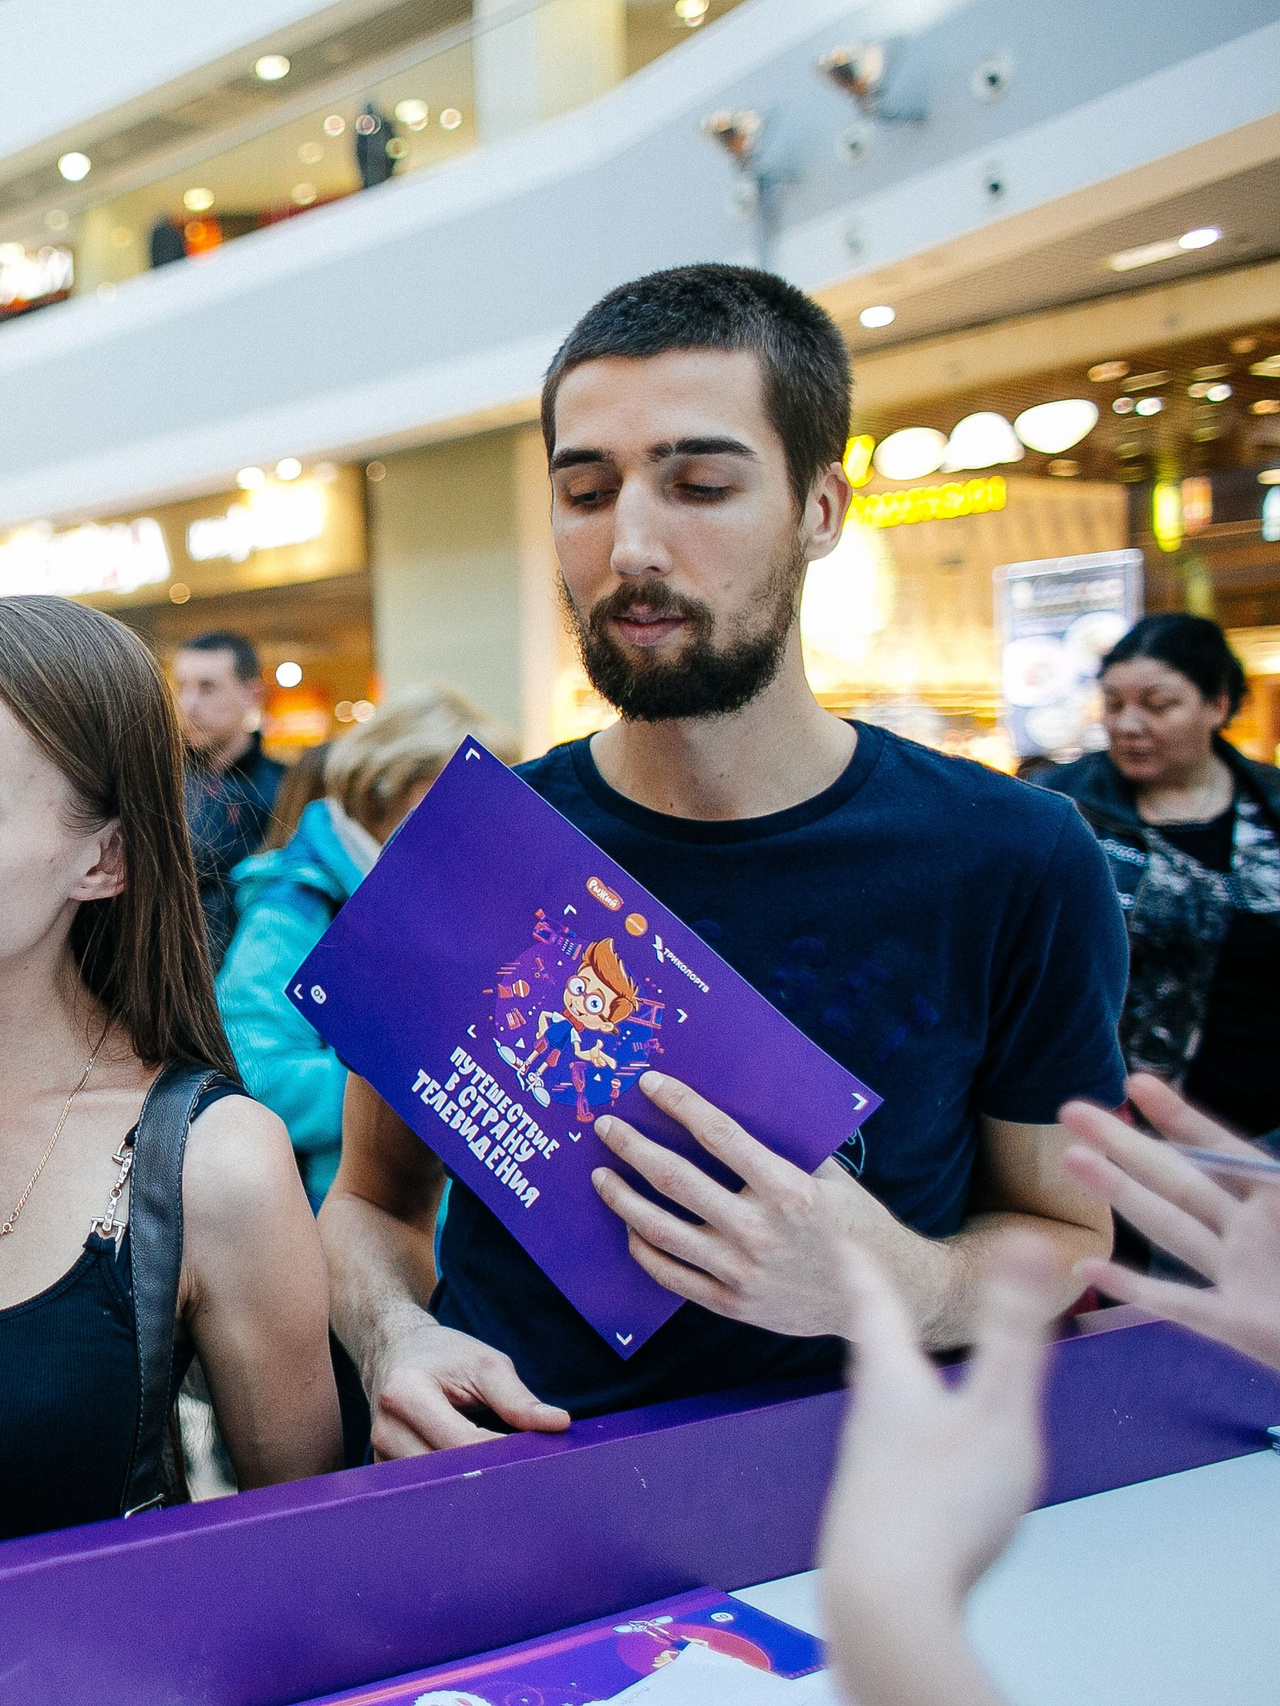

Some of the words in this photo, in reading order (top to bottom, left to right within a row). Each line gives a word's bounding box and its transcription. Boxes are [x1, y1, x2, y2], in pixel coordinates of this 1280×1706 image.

[411, 1068, 540, 1208] ТЕЛЕВИДЕНИЯ
[449, 1046, 560, 1160] ПУТЕШЕСТВИЕ
[458, 1085, 536, 1162] СТРАНУ
